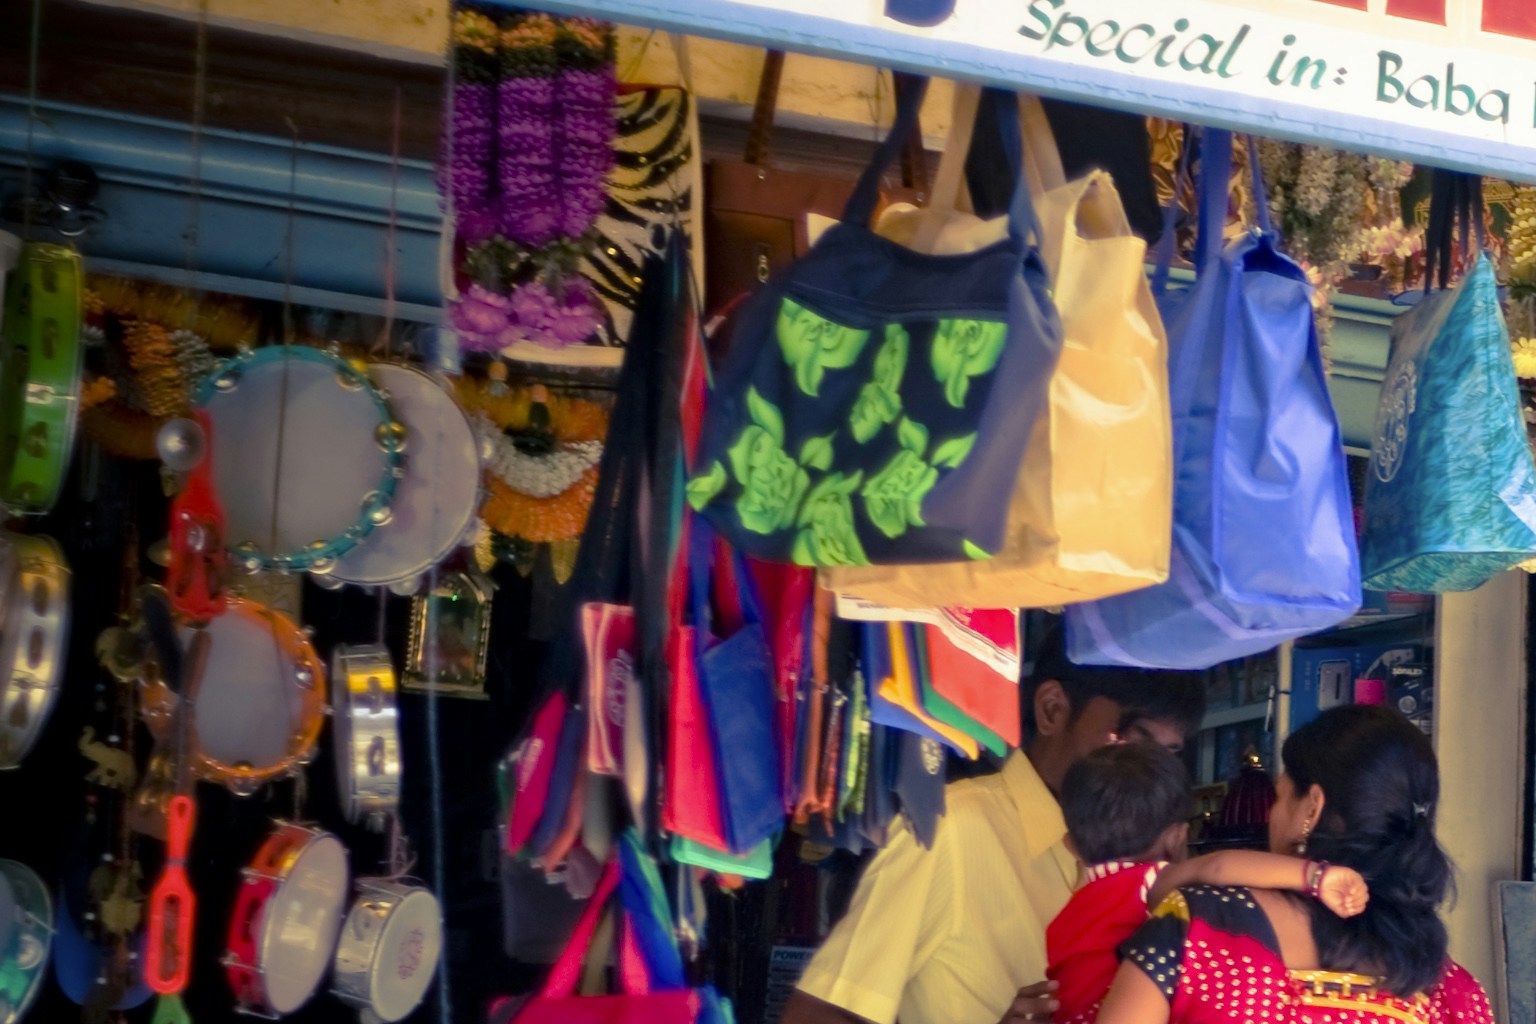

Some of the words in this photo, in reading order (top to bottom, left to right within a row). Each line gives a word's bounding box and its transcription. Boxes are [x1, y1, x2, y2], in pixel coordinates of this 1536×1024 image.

[1017, 0, 1250, 79] Special
[1267, 33, 1349, 90] in:
[1375, 50, 1511, 124] Baba
